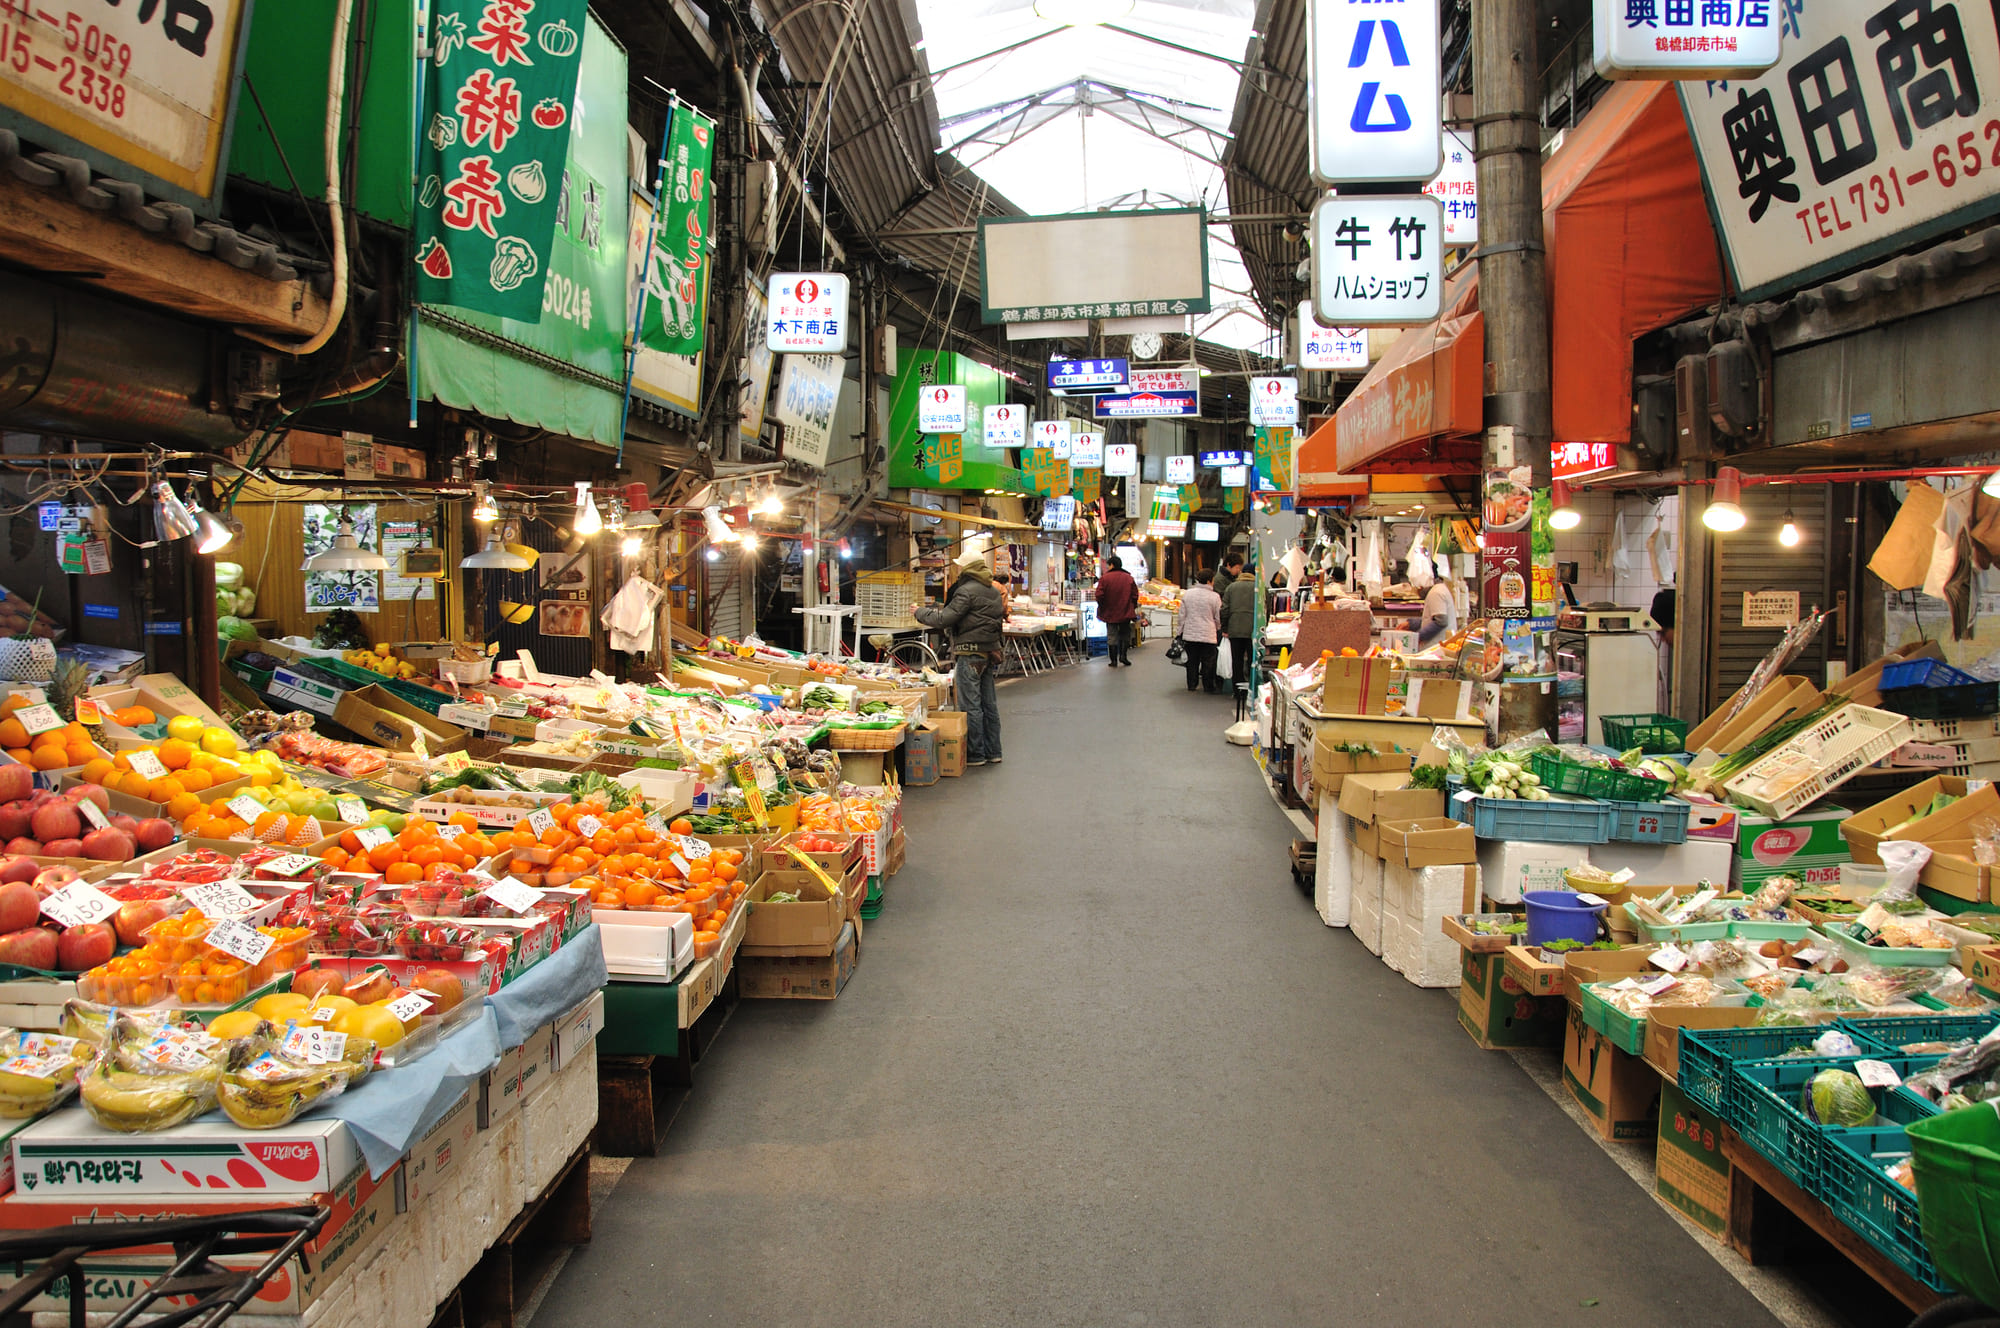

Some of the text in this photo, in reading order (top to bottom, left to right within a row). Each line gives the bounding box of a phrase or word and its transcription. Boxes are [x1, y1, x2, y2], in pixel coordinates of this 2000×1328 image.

[1624, 0, 1770, 29] 奥田商店
[1655, 36, 1738, 52] 鶴橋卸売市場
[1347, 20, 1412, 133] ハム
[1722, 0, 2000, 224] 奥田商
[1334, 216, 1427, 262] 牛竹
[1333, 274, 1430, 301] ハムショップ
[1000, 300, 1190, 323] 鶴橋卸売市場協同組合
[772, 319, 839, 336] 木下商店
[1306, 340, 1364, 355] 肉の牛竹
[1061, 361, 1114, 375] 本通り
[926, 438, 960, 463] SALE
[949, 463, 959, 477] 6
[1022, 451, 1054, 474] SALE
[1043, 473, 1053, 486] 6
[1057, 482, 1066, 494] 6
[1074, 471, 1099, 492] SALE
[317, 585, 359, 605] 水なす
[479, 810, 497, 819] Kiwi
[1763, 835, 1791, 849] 徳島
[216, 895, 251, 917] 850
[311, 1031, 323, 1060] 100
[1674, 1112, 1716, 1151] かぶら
[263, 1143, 313, 1161] 和歌山
[43, 1159, 143, 1185] たねなし柿
